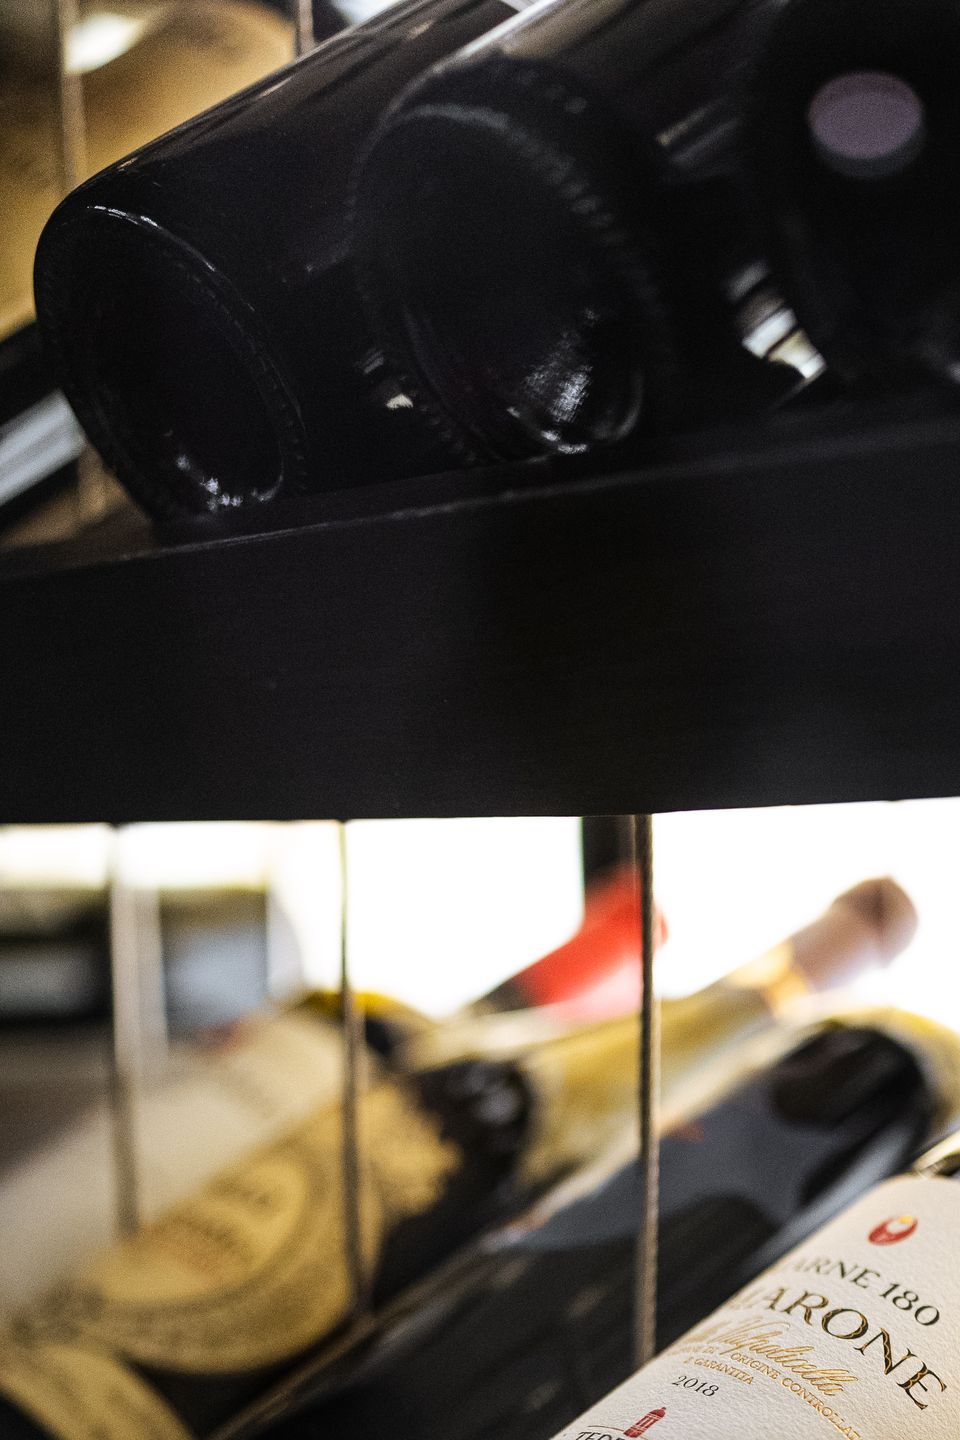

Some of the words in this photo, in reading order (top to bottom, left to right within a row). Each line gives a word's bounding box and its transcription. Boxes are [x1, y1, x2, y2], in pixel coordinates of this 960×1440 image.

[879, 1282, 940, 1326] 180
[730, 1352, 781, 1380] ORIGINE
[672, 1375, 719, 1397] 2018
